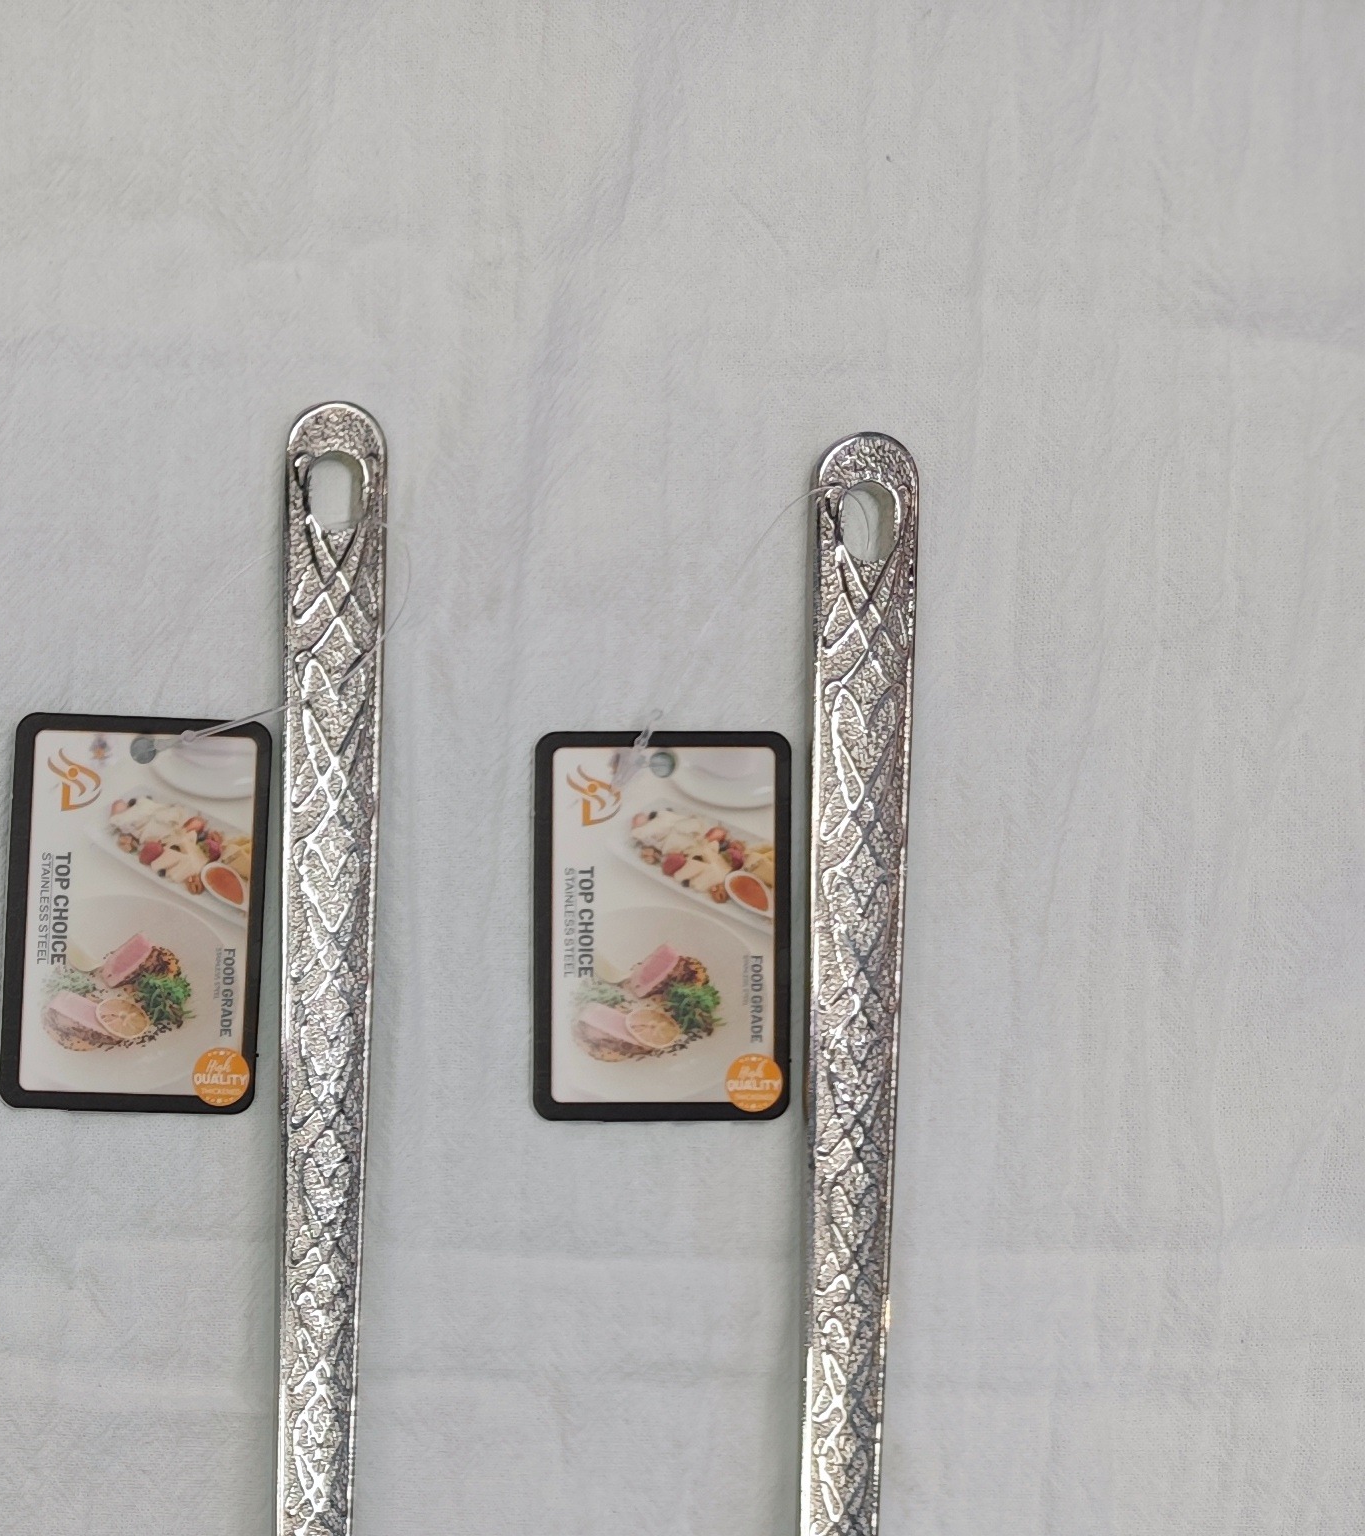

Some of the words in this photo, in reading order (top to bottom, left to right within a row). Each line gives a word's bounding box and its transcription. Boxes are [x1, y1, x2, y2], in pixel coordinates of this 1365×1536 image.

[38, 852, 51, 921] STAINLESS
[54, 851, 71, 890] TOP
[578, 865, 594, 904] TOP
[564, 867, 574, 935] STAINLESS
[36, 924, 48, 964] STEEL
[50, 894, 69, 965] CHOICE
[577, 908, 594, 978] CHOICE
[222, 948, 235, 985] FOOD
[564, 938, 574, 978] STEEL
[750, 955, 763, 992] FOOD
[219, 988, 233, 1037] GRADE
[750, 995, 762, 1043] GRADE
[193, 1072, 247, 1085] QUALITY
